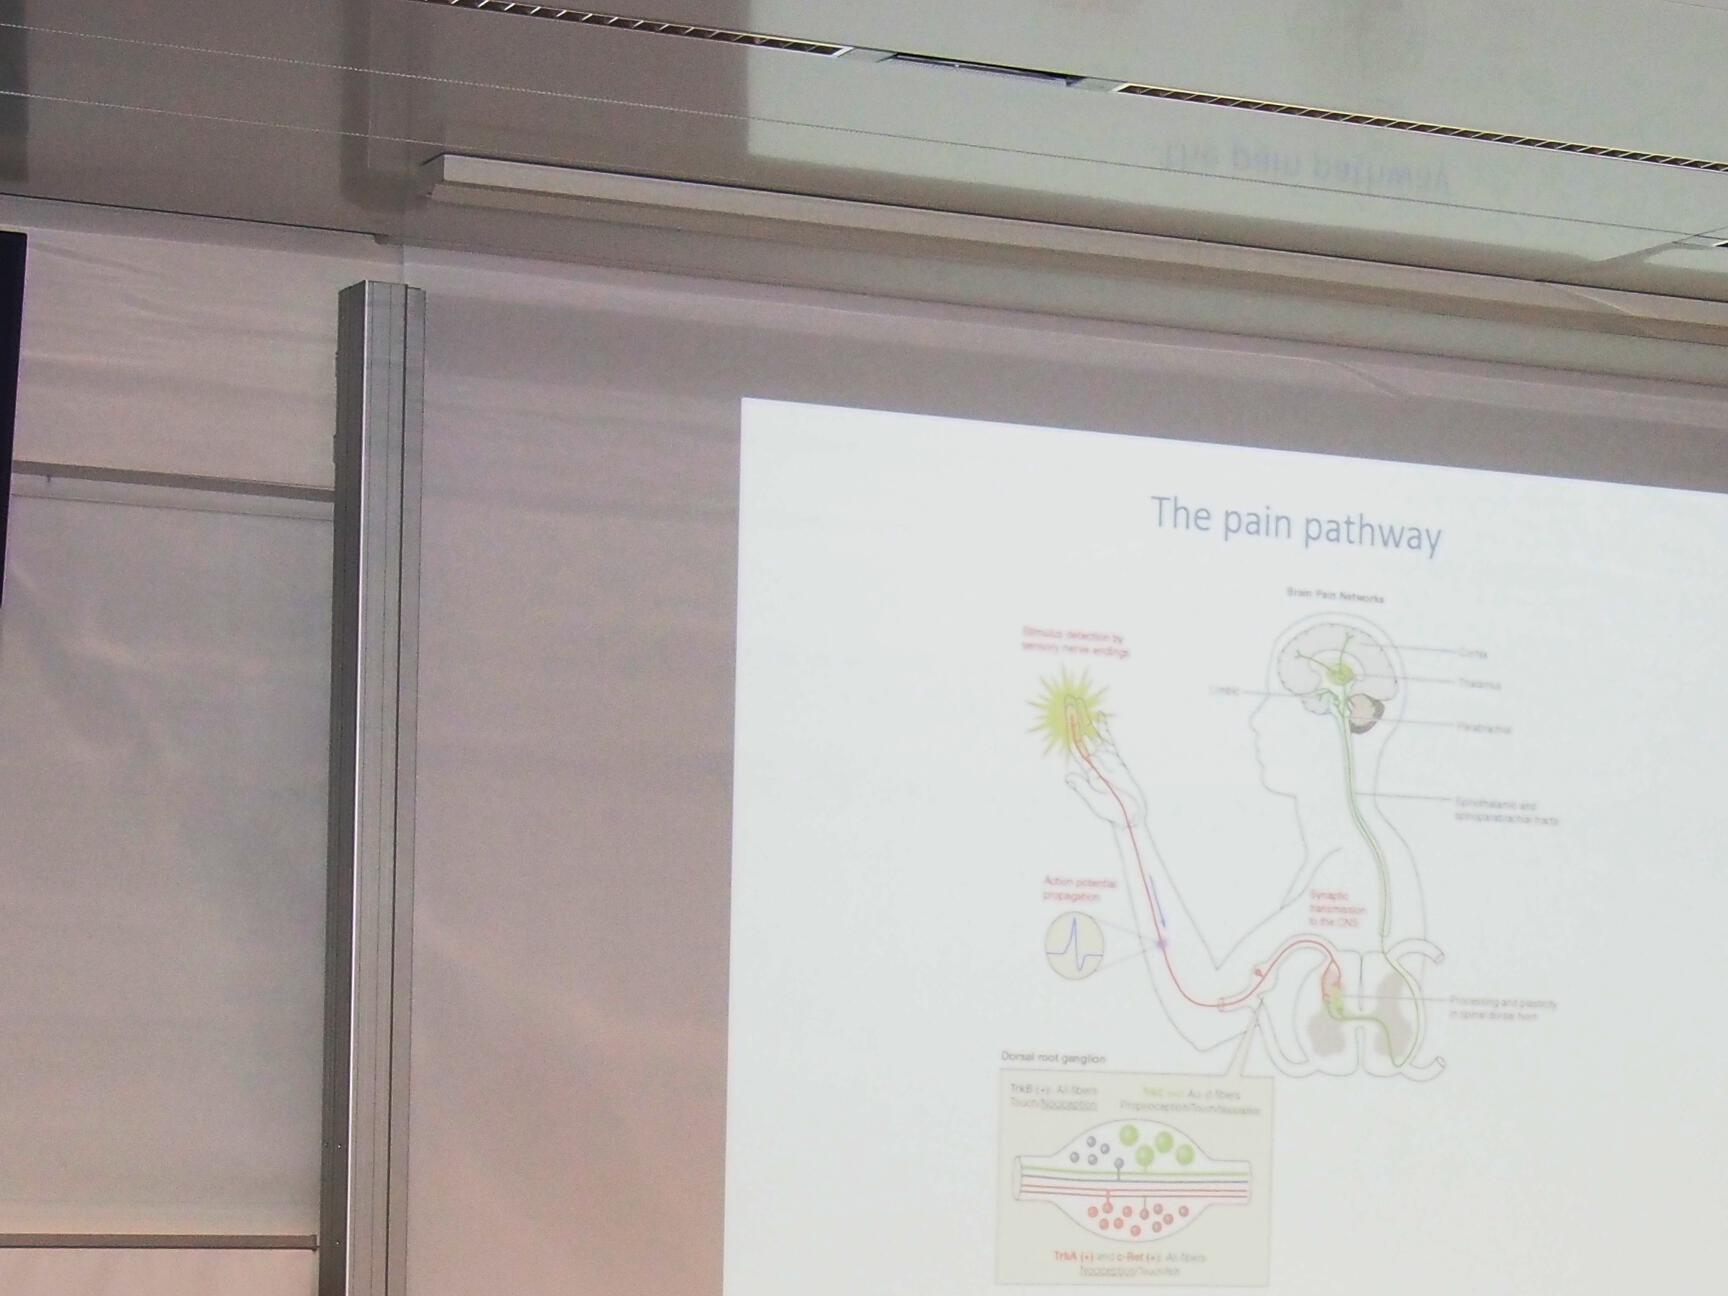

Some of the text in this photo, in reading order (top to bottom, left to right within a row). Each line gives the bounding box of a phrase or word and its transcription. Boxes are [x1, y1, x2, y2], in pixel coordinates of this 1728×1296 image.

[1151, 494, 1443, 560] The pain pathway
[1339, 590, 1385, 604] Networks
[1001, 1050, 1106, 1066] Dorsal root ganglion
